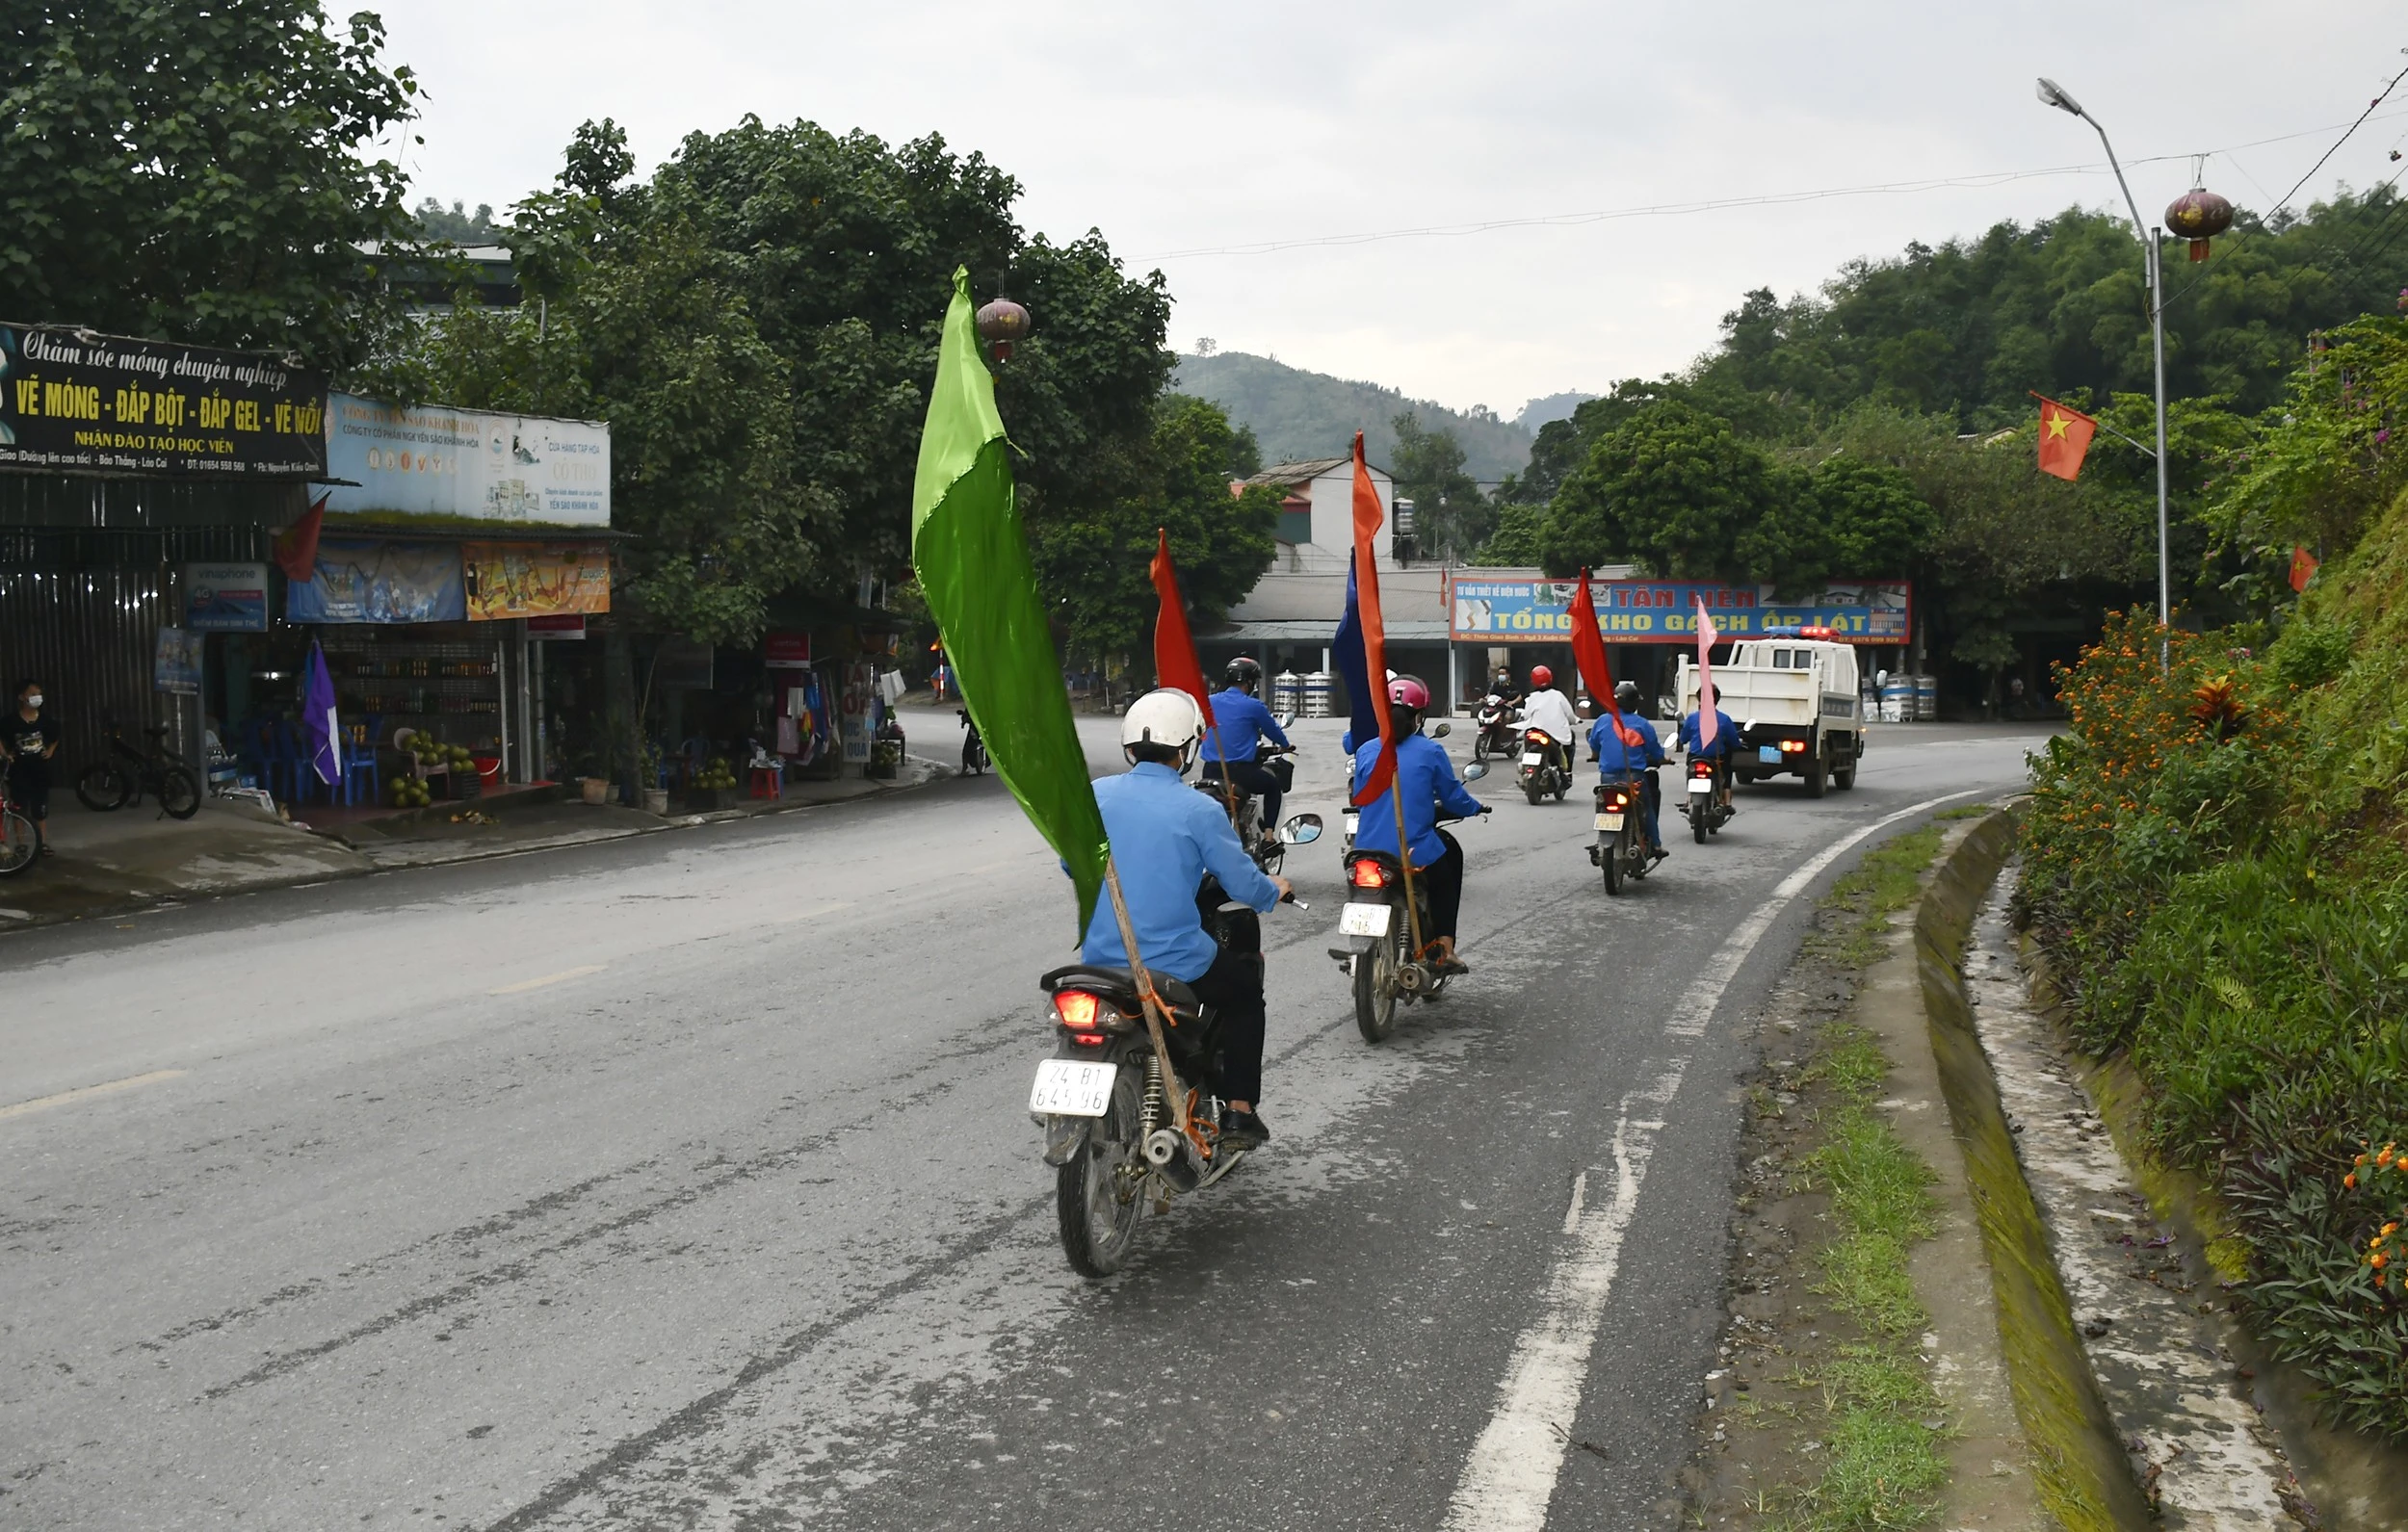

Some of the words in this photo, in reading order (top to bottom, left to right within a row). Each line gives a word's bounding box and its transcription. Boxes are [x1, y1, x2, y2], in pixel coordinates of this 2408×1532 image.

[23, 330, 80, 364] Chăm
[86, 342, 116, 368] sóc
[118, 347, 169, 378] móng
[173, 352, 230, 383] chuyên
[235, 361, 288, 392] nghiệp
[16, 374, 39, 416] VẼ
[44, 377, 99, 420] MÓNG
[116, 380, 149, 424] ĐẮP
[155, 386, 186, 432] BỘT
[200, 388, 231, 429] ĐẮP
[234, 401, 261, 432] GEL
[275, 399, 291, 433] VẼ
[295, 397, 322, 434] NỔI
[74, 428, 112, 450] NHẬN
[115, 432, 144, 450] ĐÀO
[148, 436, 175, 454] TẠO
[178, 438, 204, 455] HỌC
[208, 437, 234, 454] VIÊN
[198, 567, 255, 580] vinaphone
[1615, 585, 1675, 608] TÂN
[1495, 607, 1572, 630] TỔNG
